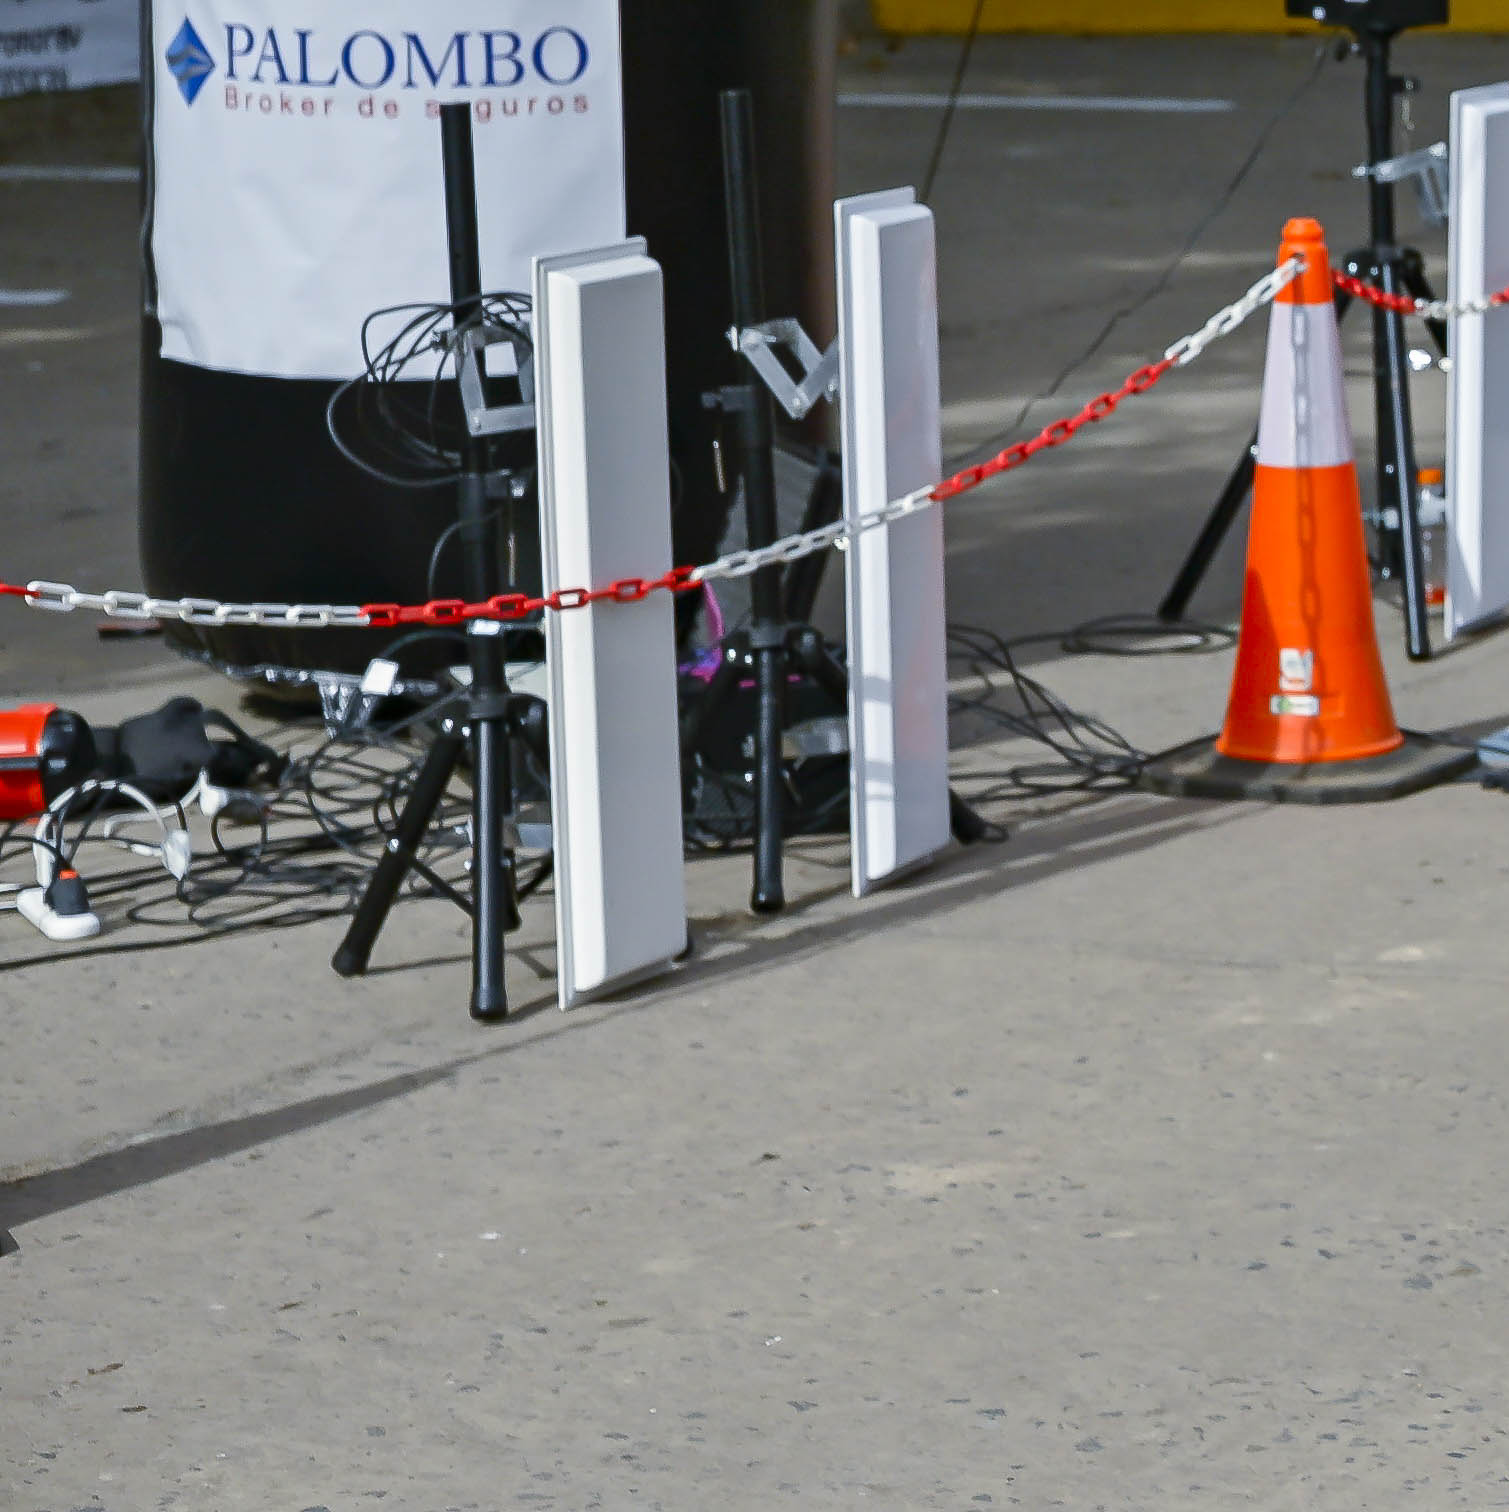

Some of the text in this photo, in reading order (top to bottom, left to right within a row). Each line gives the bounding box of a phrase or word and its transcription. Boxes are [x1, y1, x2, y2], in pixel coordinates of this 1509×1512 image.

[223, 23, 590, 89] PALOMBO
[223, 83, 589, 123] Broker de sguros
